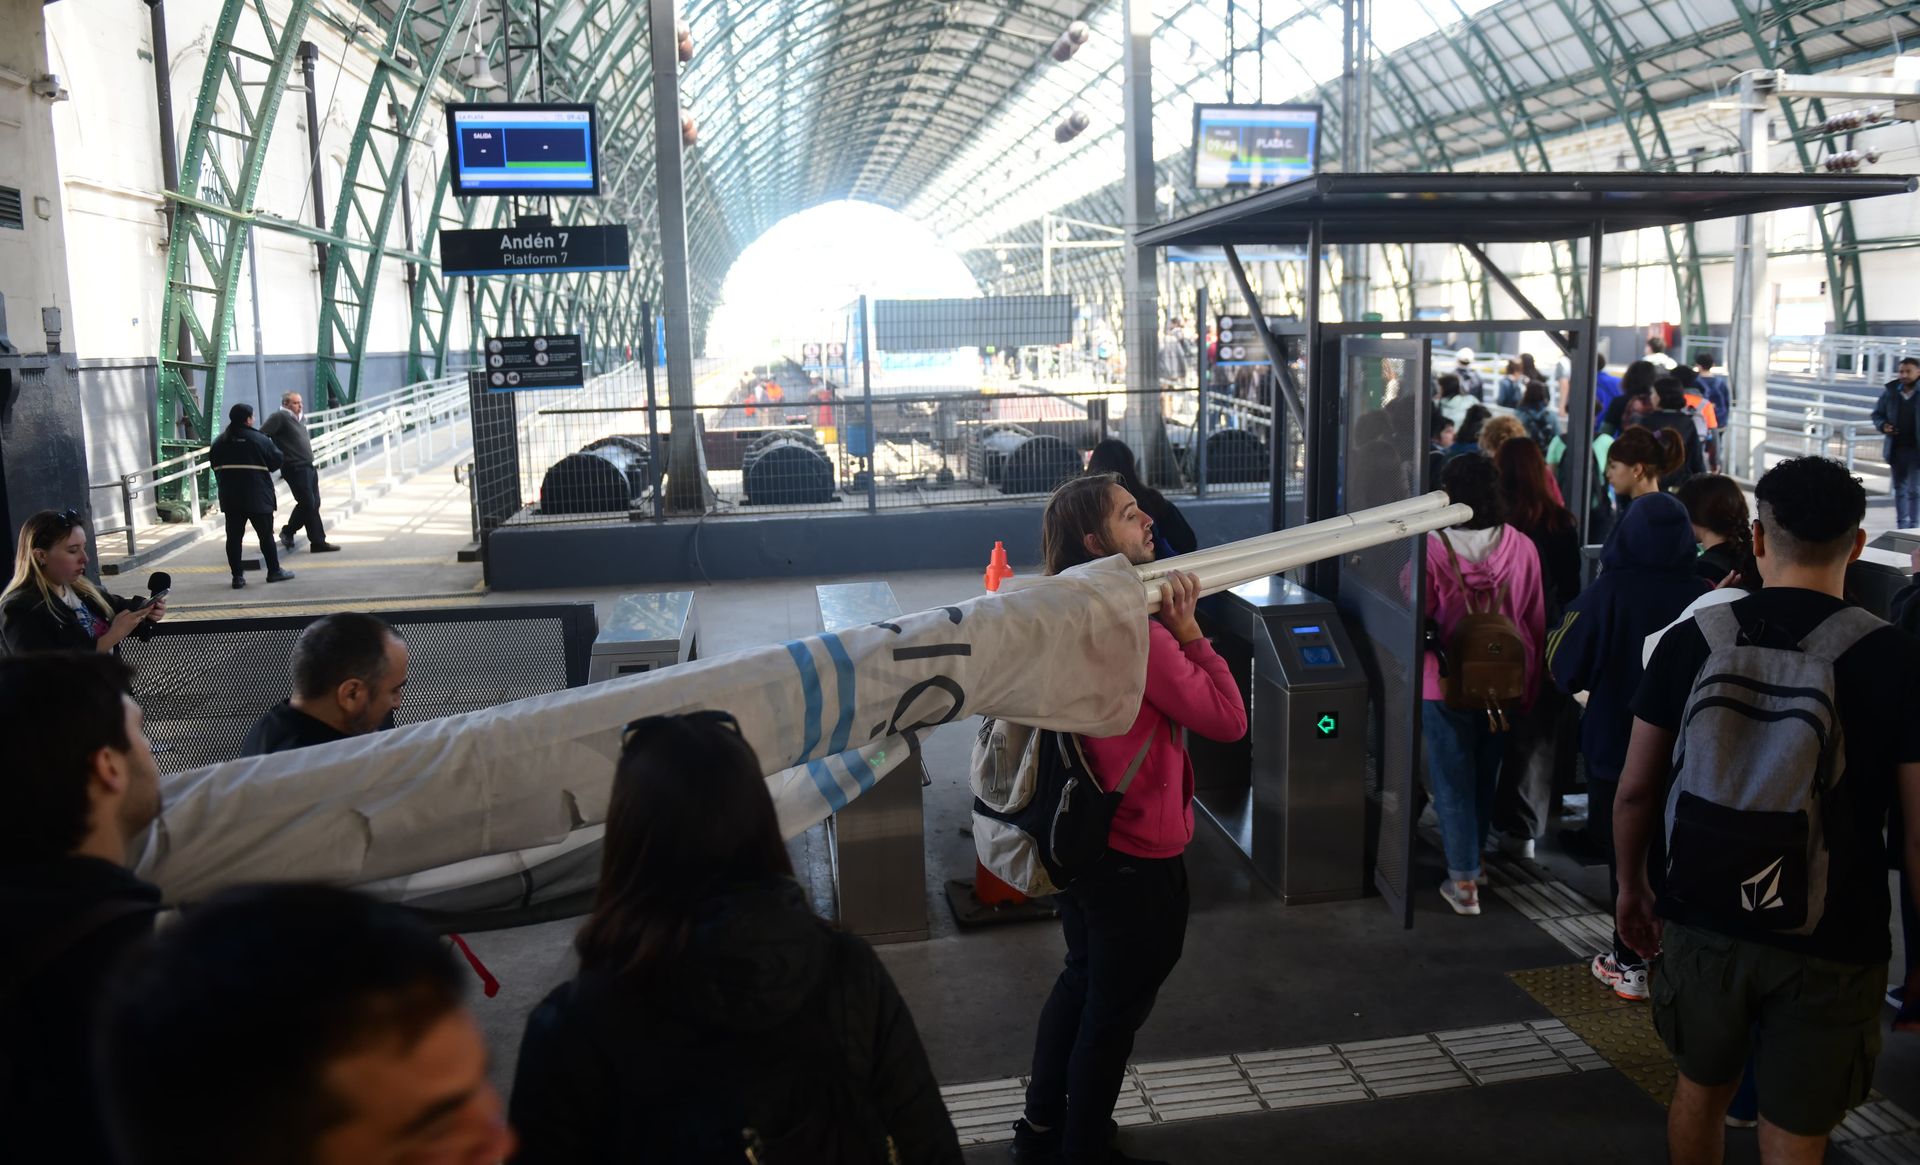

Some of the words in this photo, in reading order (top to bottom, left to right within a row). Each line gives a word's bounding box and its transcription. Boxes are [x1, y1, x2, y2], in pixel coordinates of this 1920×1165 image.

[473, 132, 492, 140] SALIDA
[500, 232, 555, 250] Andén
[558, 232, 569, 248] 7
[503, 252, 557, 265] Platform
[560, 251, 568, 263] 7
